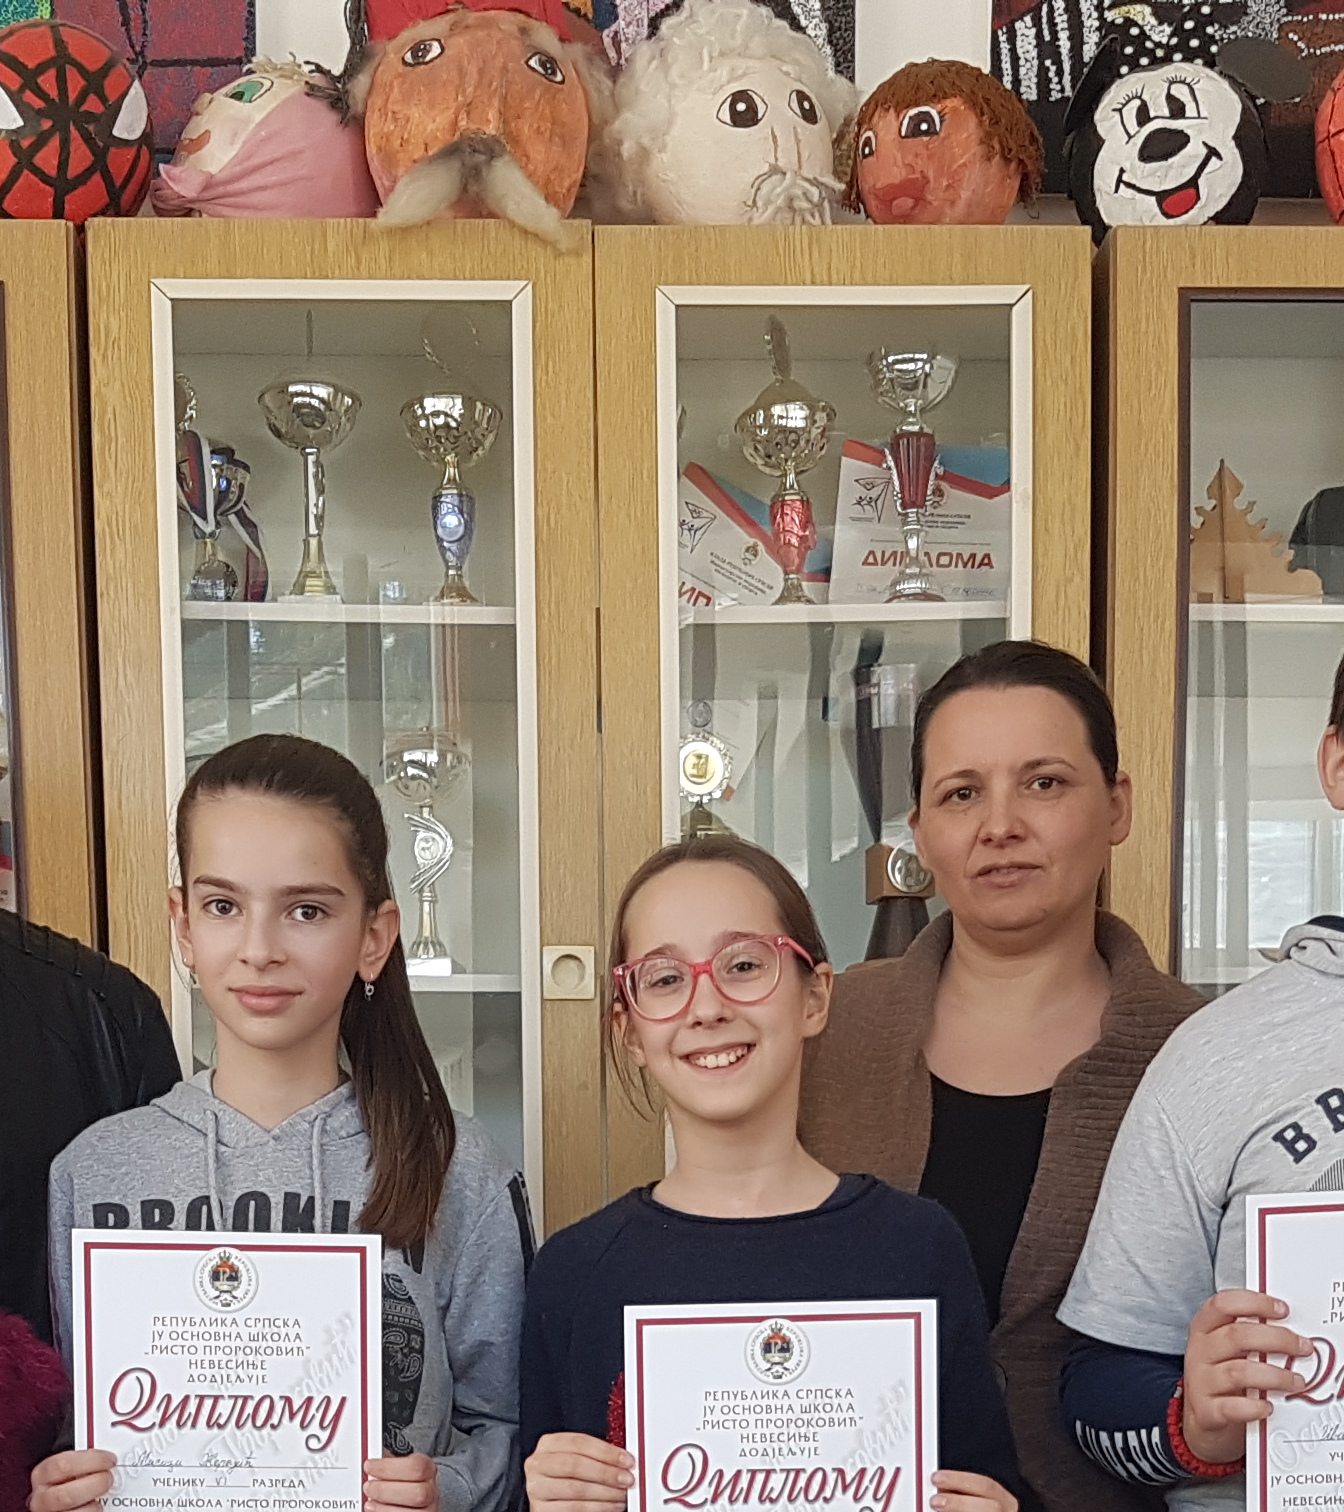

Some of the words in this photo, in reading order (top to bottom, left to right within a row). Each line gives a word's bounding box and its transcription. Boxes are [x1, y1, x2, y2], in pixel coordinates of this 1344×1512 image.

[1331, 1296, 1344, 1311] ЈУ
[153, 1316, 240, 1328] РЕПУБЛИКА
[243, 1317, 301, 1329] СРПСКА
[151, 1330, 165, 1344] ЈУ
[168, 1330, 244, 1342] ОСНОВНА
[248, 1331, 303, 1343] ШКОЛА
[188, 1358, 267, 1371] НЕВЕСИЊЕ
[186, 1373, 268, 1386] ДОДЈЕЉУЈЕ
[704, 1389, 791, 1402] РЕПУБЛИКА
[795, 1387, 855, 1400] СРПСКА
[109, 1367, 348, 1452] Диплому
[703, 1404, 716, 1418] ЈУ
[720, 1403, 795, 1416] ОСНОВНА
[799, 1402, 855, 1414] ШКОЛА
[740, 1431, 819, 1444] НЕВЕСИЊЕ
[738, 1446, 820, 1459] ДОДЈЕЉУЈЕ
[151, 1477, 205, 1488] УЧЕНИКУ
[252, 1478, 306, 1489] РАЗРЕДА
[1270, 1475, 1282, 1488] ЈУ
[111, 1497, 174, 1508] ОСНОВНА
[177, 1498, 223, 1508] ШКОЛА
